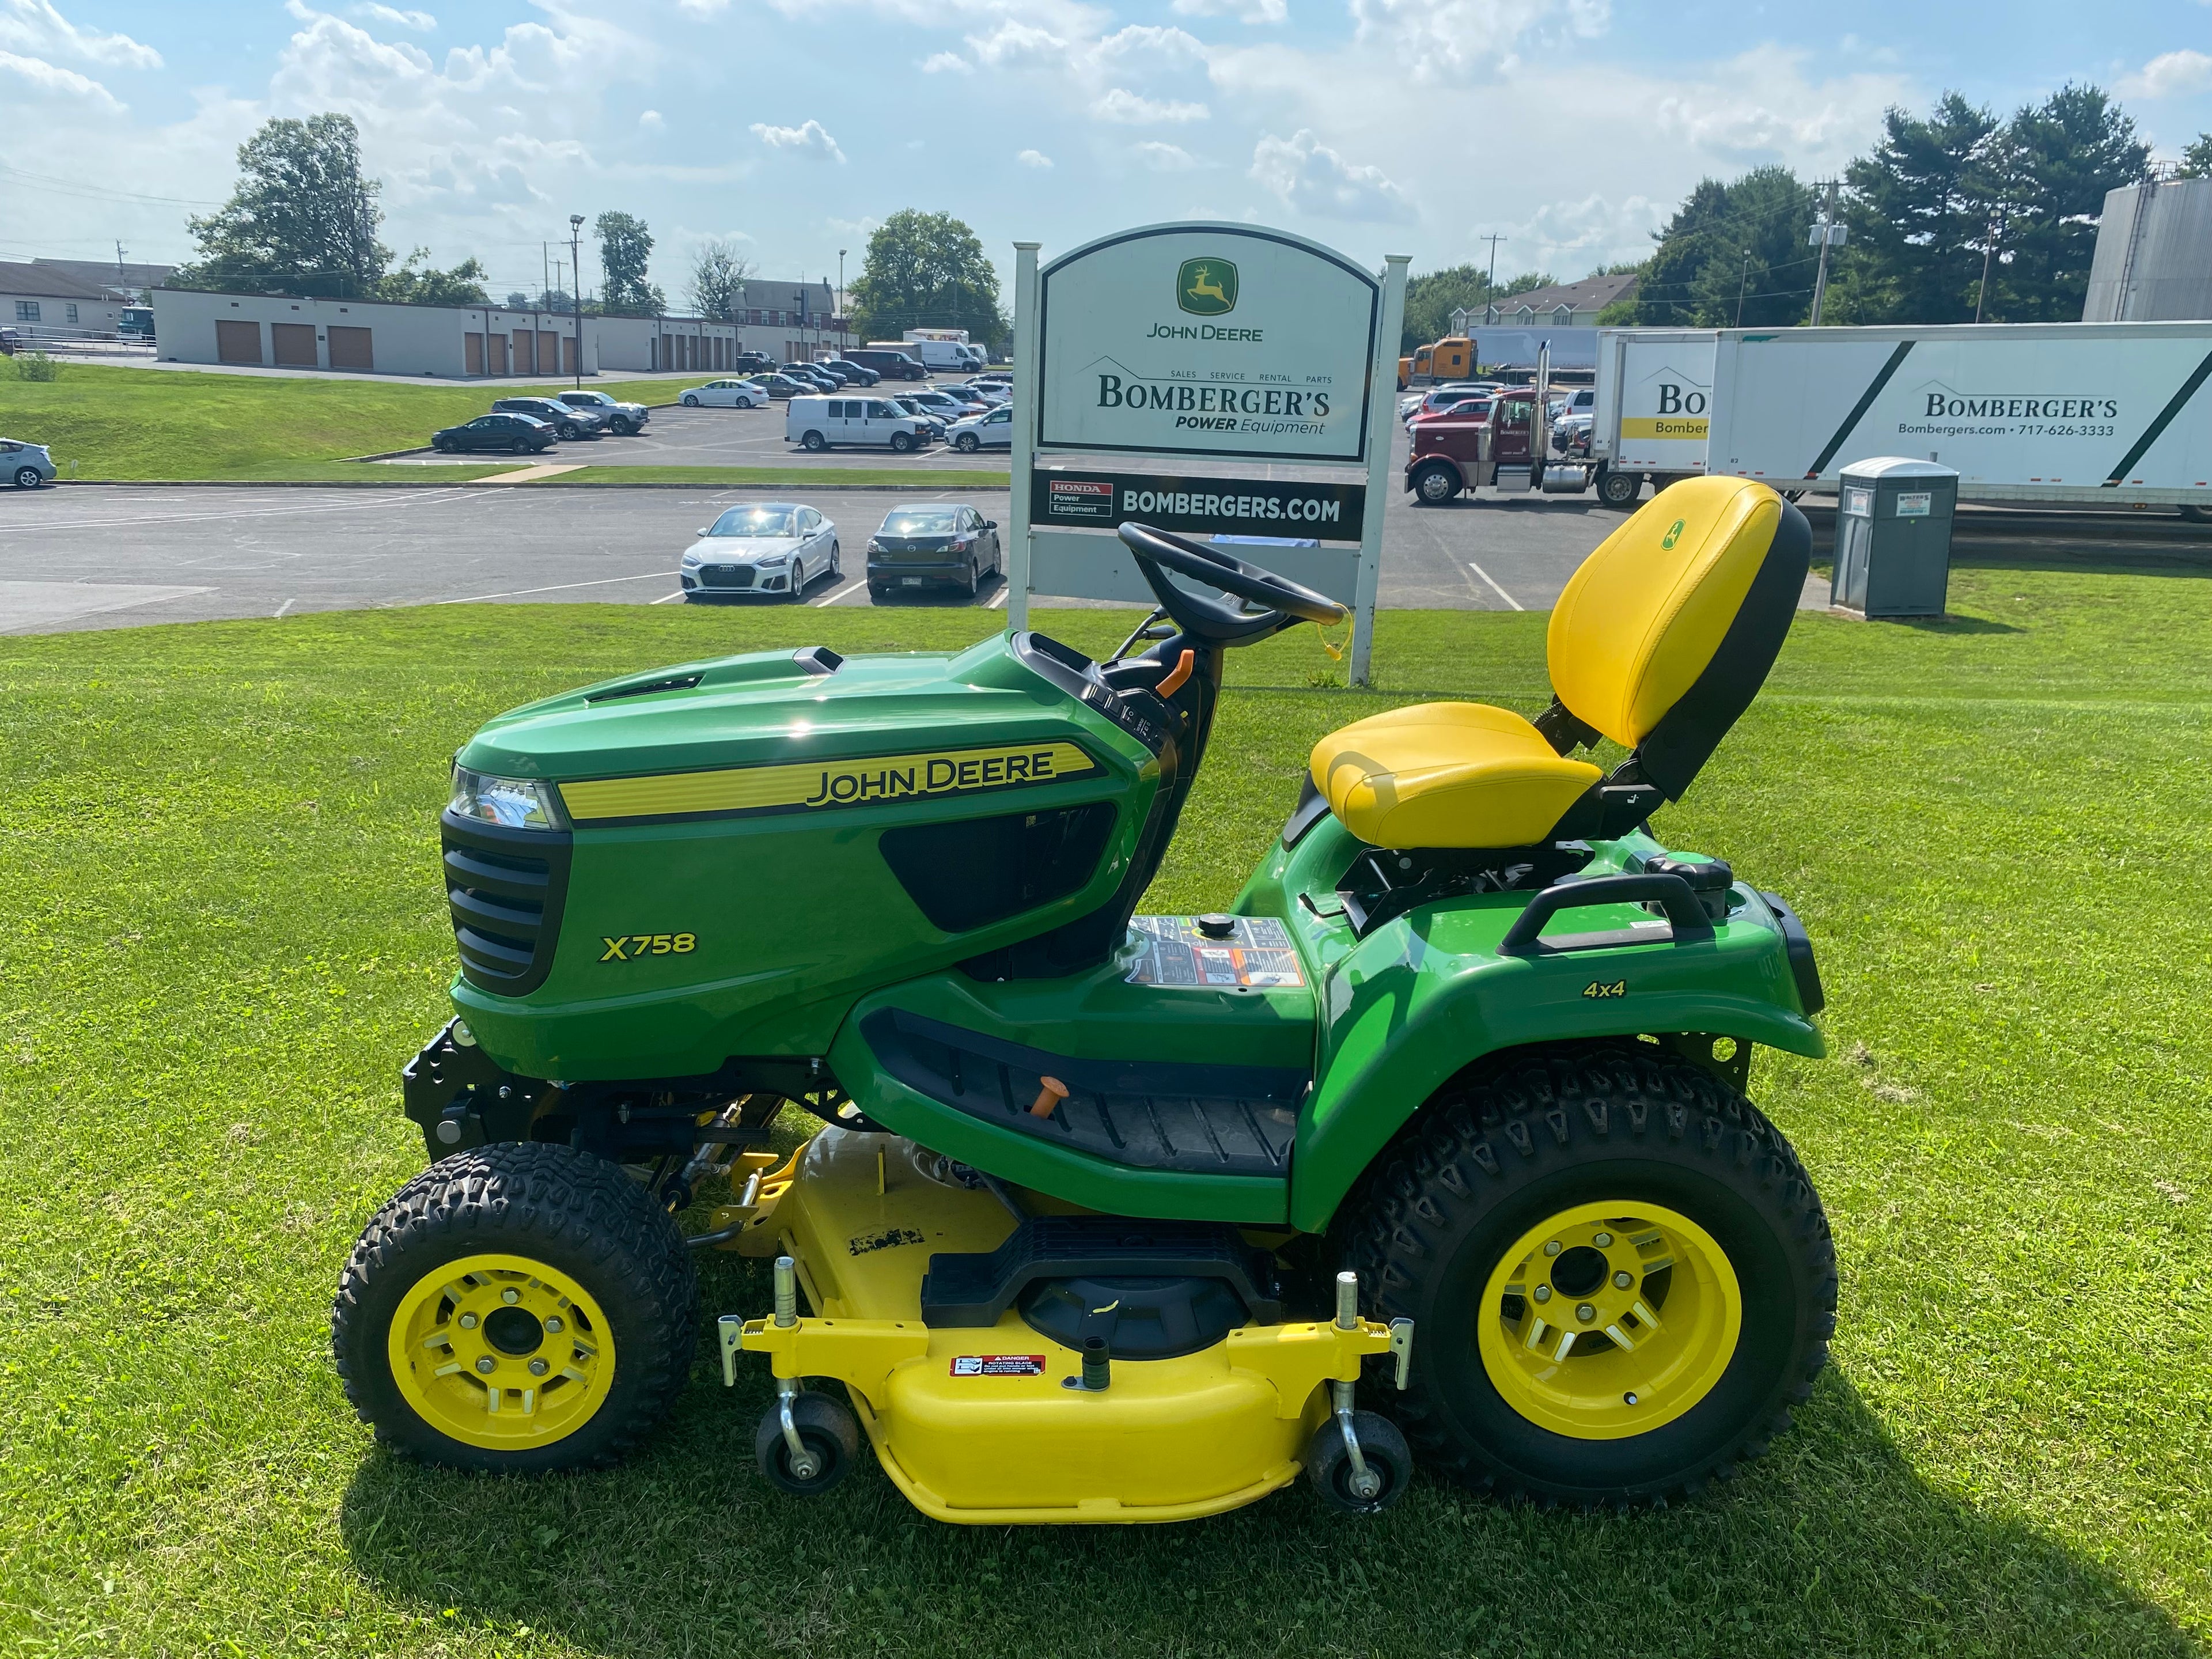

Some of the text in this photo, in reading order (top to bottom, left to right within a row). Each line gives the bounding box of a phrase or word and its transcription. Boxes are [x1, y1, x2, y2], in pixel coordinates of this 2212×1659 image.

[1146, 323, 1263, 342] JOHN DEERE
[1171, 370, 1332, 384] SALES SERVICE RENTAL PARTS
[1097, 374, 1330, 416] BOMBERGER'S
[1925, 393, 2118, 418] BOMBERGER'S
[1175, 415, 1325, 435] POWER Equipment
[1899, 423, 2114, 437] Bombergers.com 717-626-3333
[1054, 484, 1101, 493] HONDA
[1054, 494, 1080, 503] Power
[1123, 490, 1340, 522] BOMBERGERS.COM
[1054, 504, 1097, 514] Equipment
[807, 752, 1054, 802] JOHN DEERE
[601, 933, 696, 961] X758
[1583, 980, 1625, 998] 4x4
